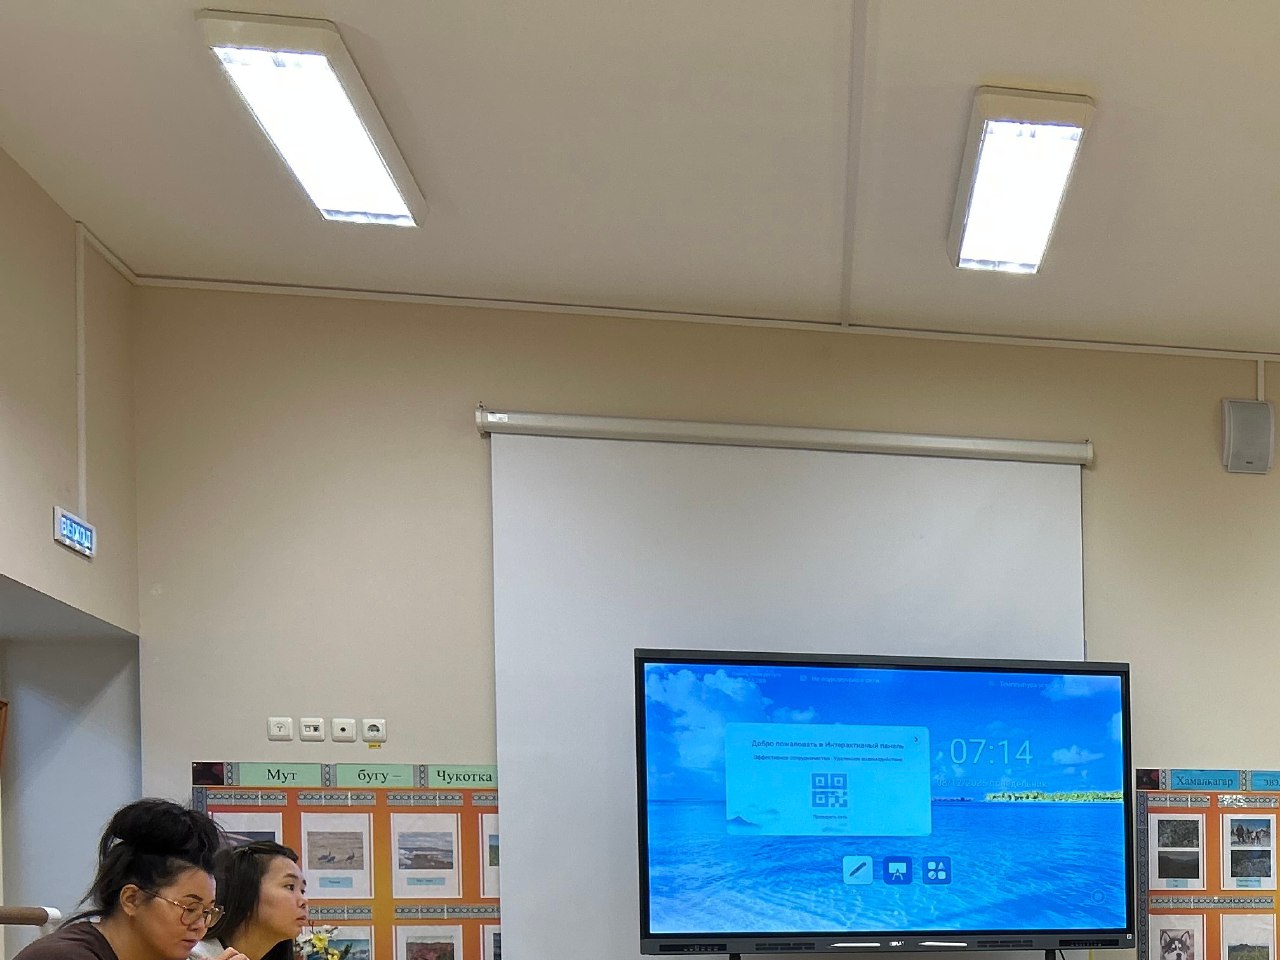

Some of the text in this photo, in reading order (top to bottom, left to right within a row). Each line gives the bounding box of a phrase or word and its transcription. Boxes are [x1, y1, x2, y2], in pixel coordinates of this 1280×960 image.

[61, 516, 91, 549] ВЫХОД
[752, 739, 775, 748] Добро
[825, 741, 879, 749] Интерактивный
[950, 738, 1033, 764] 07:14
[267, 769, 298, 783] Мут
[357, 769, 390, 783] бугу
[436, 769, 493, 784] Чукотка
